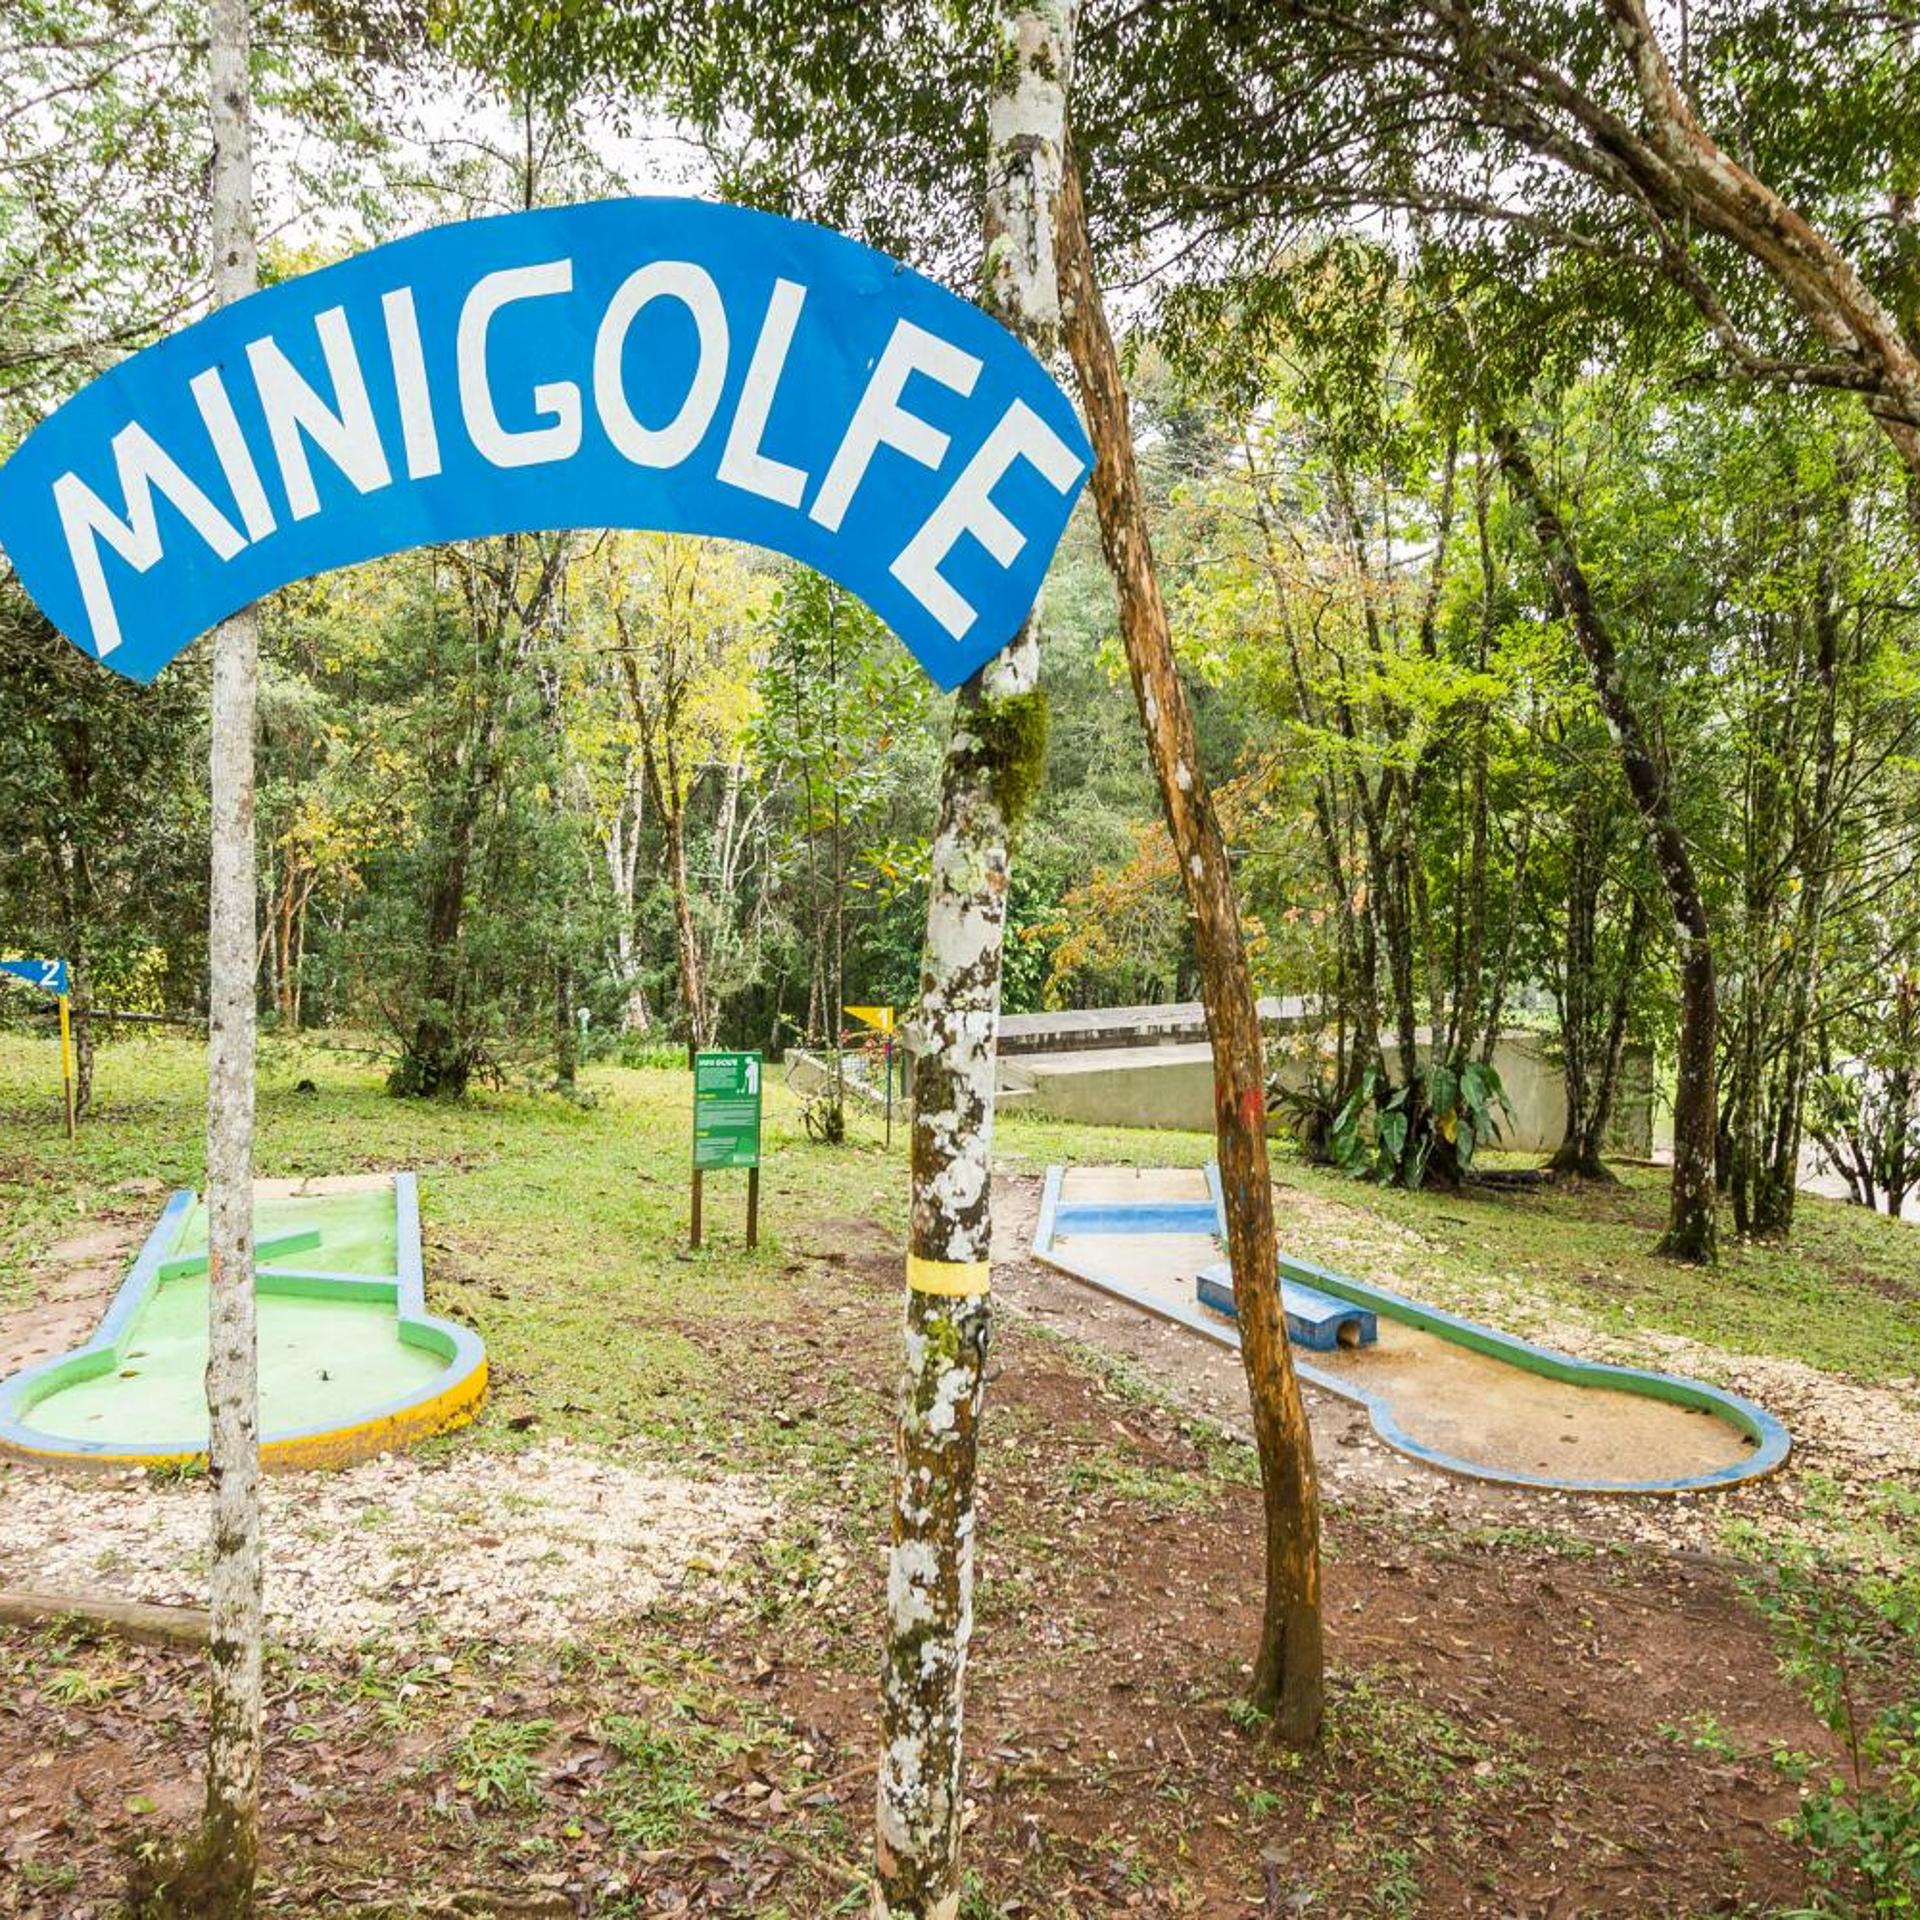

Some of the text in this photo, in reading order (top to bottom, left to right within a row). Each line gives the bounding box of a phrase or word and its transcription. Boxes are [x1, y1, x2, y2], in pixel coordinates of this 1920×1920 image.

[53, 259, 1084, 657] MINIGOLFE
[40, 960, 60, 985] 2
[879, 1007, 888, 1027] 1
